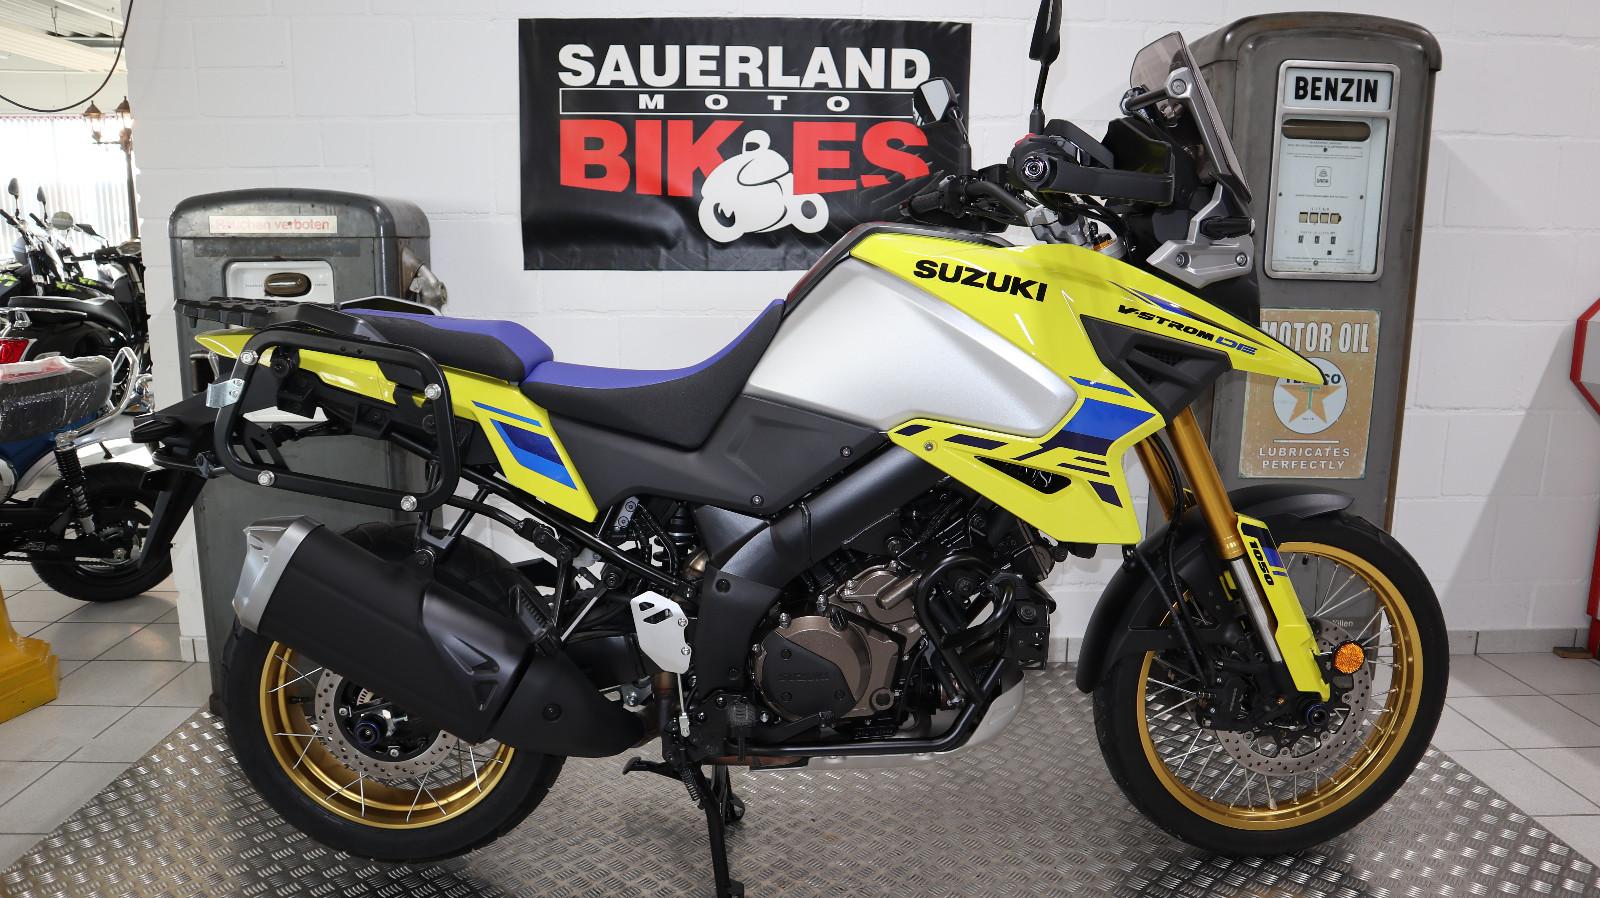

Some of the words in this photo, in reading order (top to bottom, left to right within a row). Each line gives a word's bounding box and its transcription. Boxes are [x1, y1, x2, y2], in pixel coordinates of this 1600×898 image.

[558, 44, 931, 89] SAUERLAND
[638, 93, 850, 112] MOTO
[1294, 76, 1379, 103] BENZIN
[559, 119, 930, 197] BIKES
[274, 218, 330, 230] verboten
[913, 259, 1048, 303] SUZUKI
[1117, 304, 1215, 342] V-STROM
[1215, 335, 1258, 355] DE
[1338, 322, 1370, 353] OIL
[1259, 447, 1350, 457] LUBRICATES
[1262, 460, 1345, 470] PERFECTLY
[1249, 540, 1275, 585] 1050
